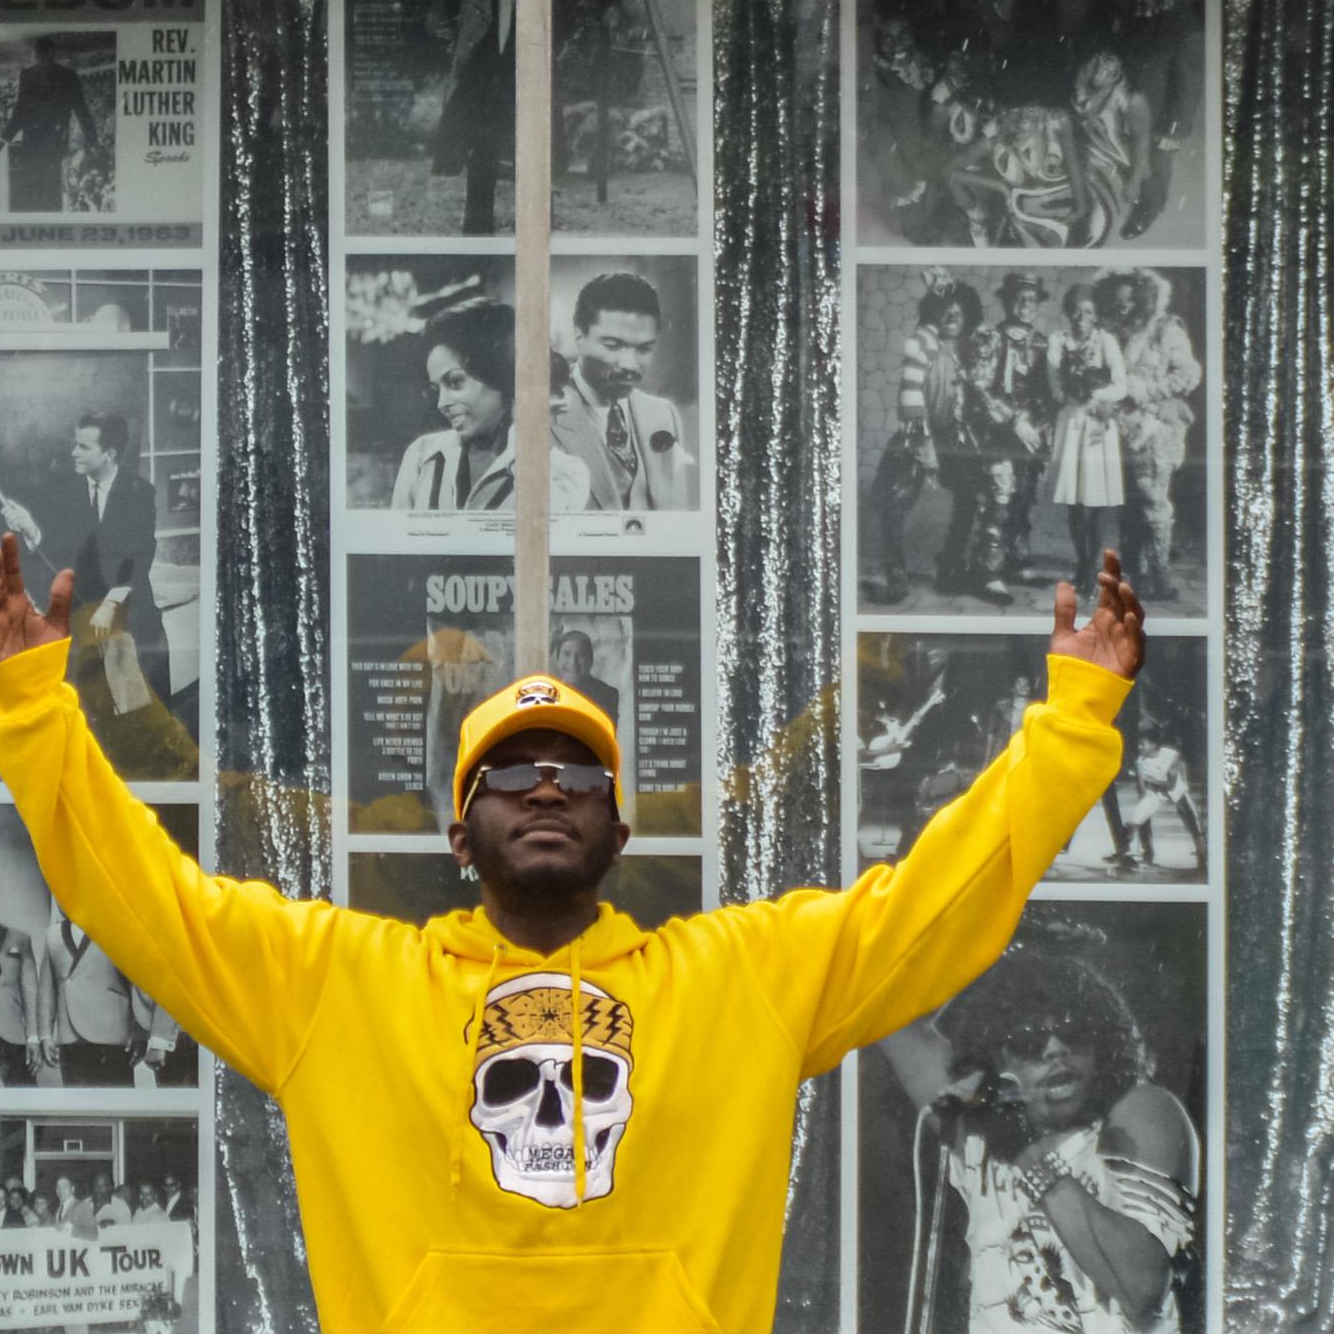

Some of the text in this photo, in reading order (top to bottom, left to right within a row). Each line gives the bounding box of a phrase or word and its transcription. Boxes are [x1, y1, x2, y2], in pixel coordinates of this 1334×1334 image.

[152, 28, 196, 54] REV.
[118, 59, 196, 84] MARTIN
[123, 91, 195, 116] LUTHER
[148, 122, 195, 146] KING
[1, 226, 74, 244] JUNE
[46, 1248, 91, 1279] UK
[99, 1245, 164, 1275] TOUR
[13, 1286, 71, 1301] ROBINSON
[74, 1285, 95, 1297] AND
[98, 1284, 117, 1296] THE
[33, 1304, 58, 1317] EARL
[62, 1301, 83, 1313] VAN
[87, 1300, 114, 1313] DYKE
